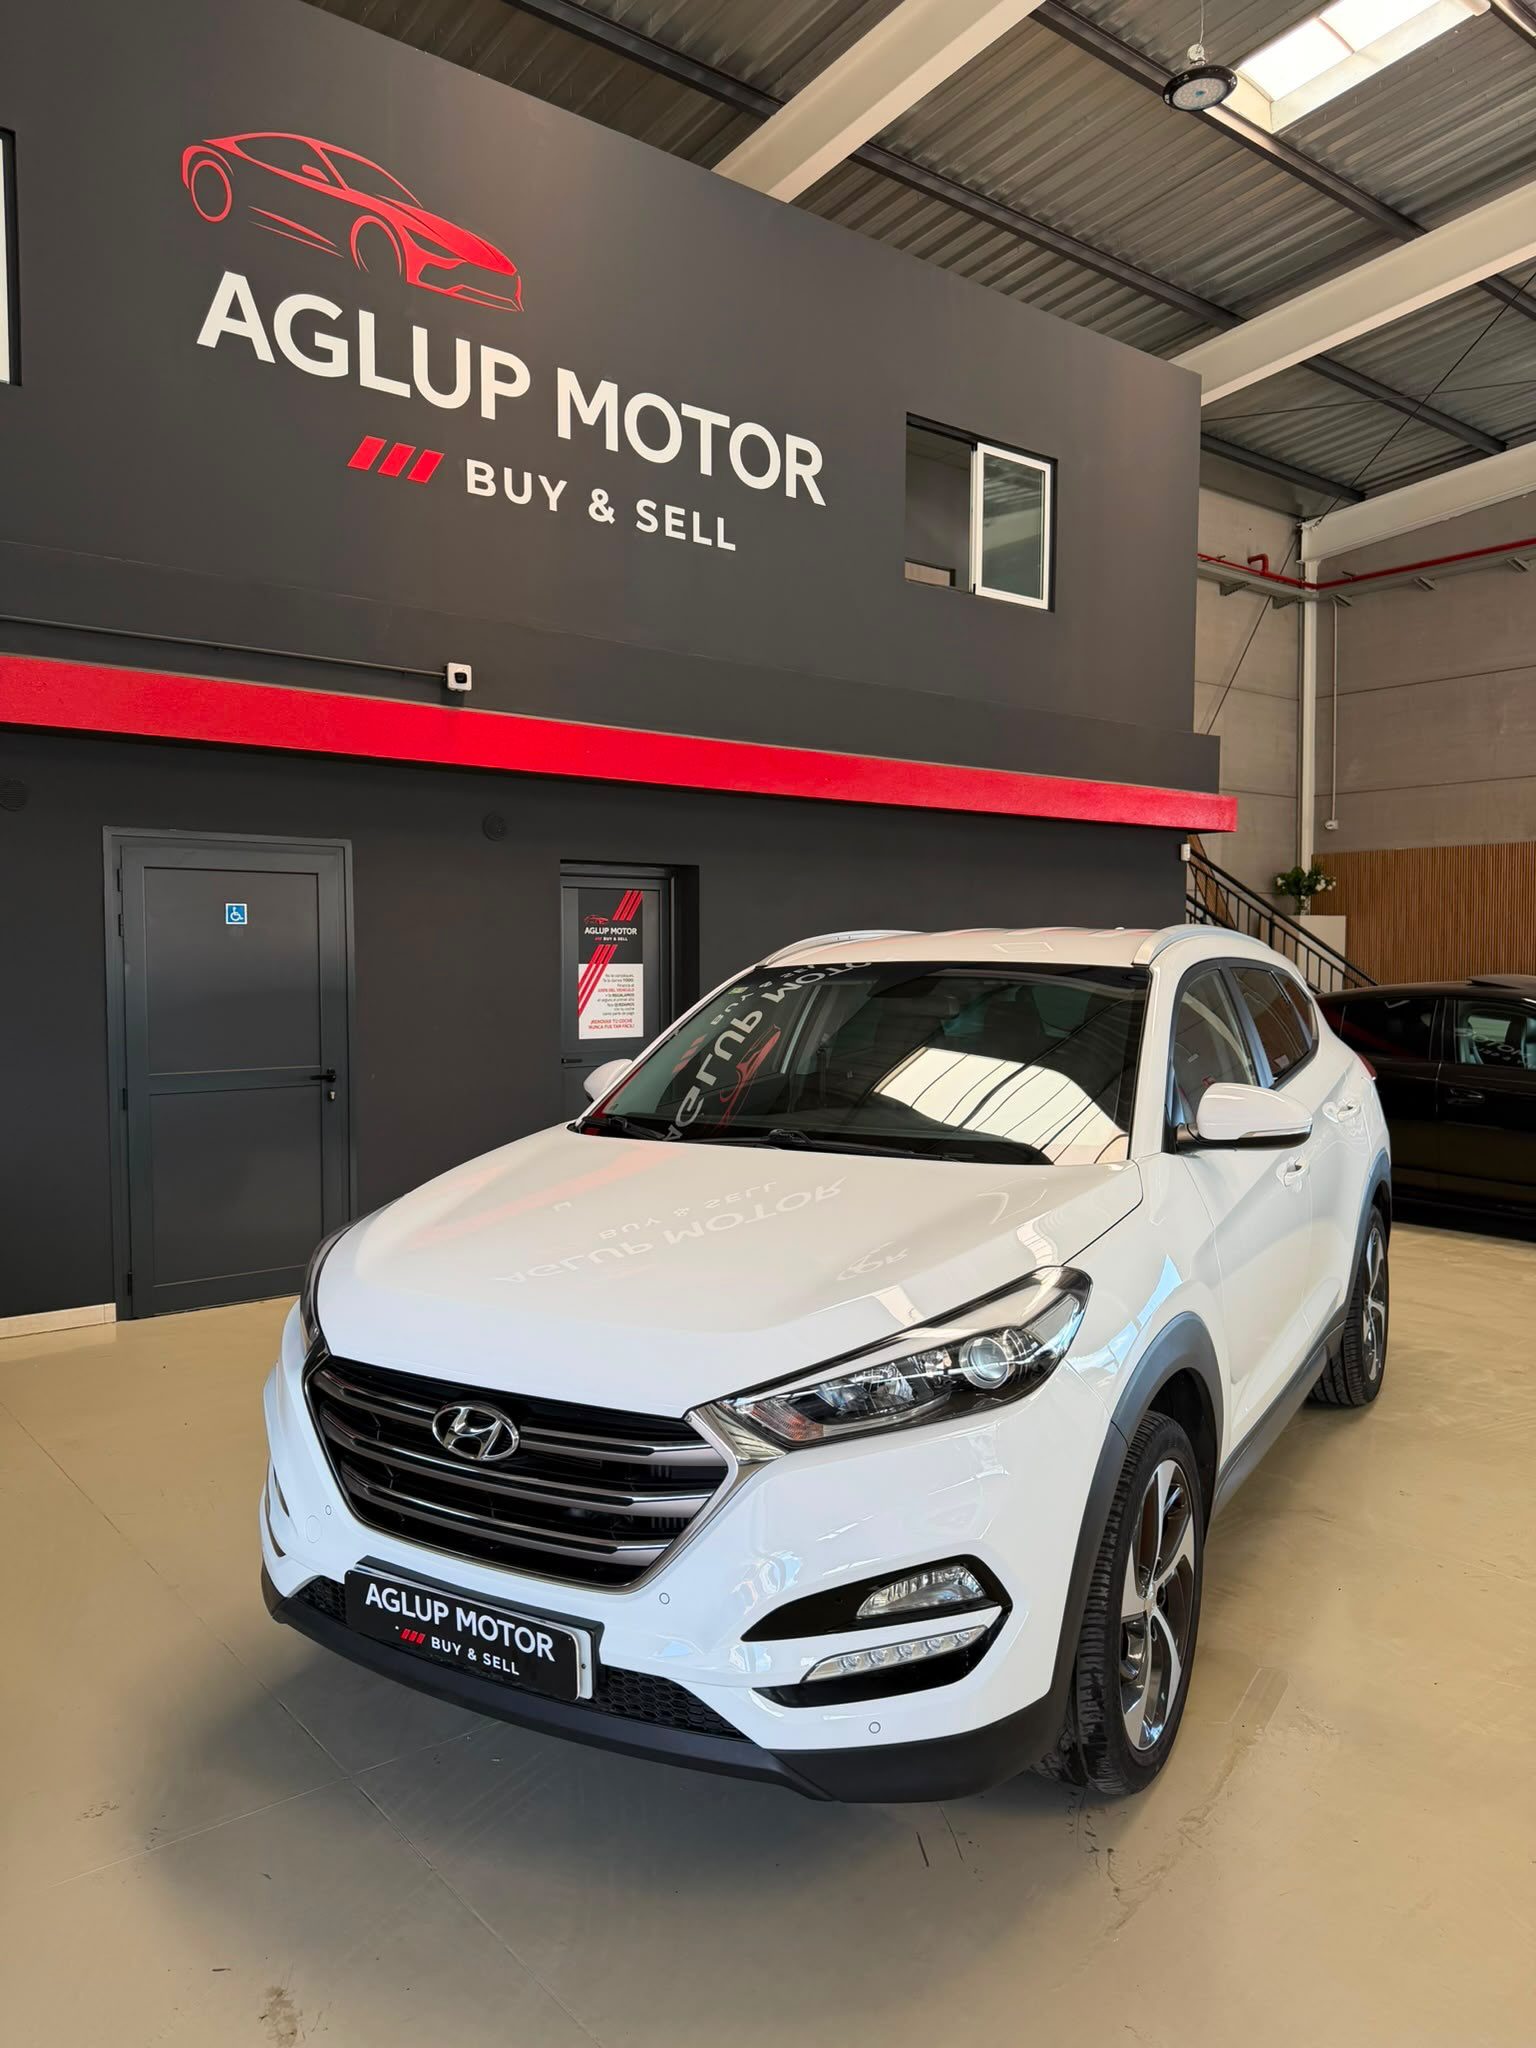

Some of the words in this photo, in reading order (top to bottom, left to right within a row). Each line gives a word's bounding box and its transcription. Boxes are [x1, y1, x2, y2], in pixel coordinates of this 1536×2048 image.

[196, 270, 531, 420] AGLUP
[556, 367, 826, 506] MOTOR
[466, 458, 567, 512] BUY
[588, 488, 615, 524] &
[636, 499, 736, 552] SELL
[584, 926, 609, 935] AGLUP
[611, 927, 637, 935] MOTOR
[364, 1582, 449, 1626] AGLUP
[456, 1606, 555, 1662] MOTOR
[431, 1636, 462, 1656] BUY
[467, 1648, 477, 1661] &
[483, 1652, 520, 1676] SELL
